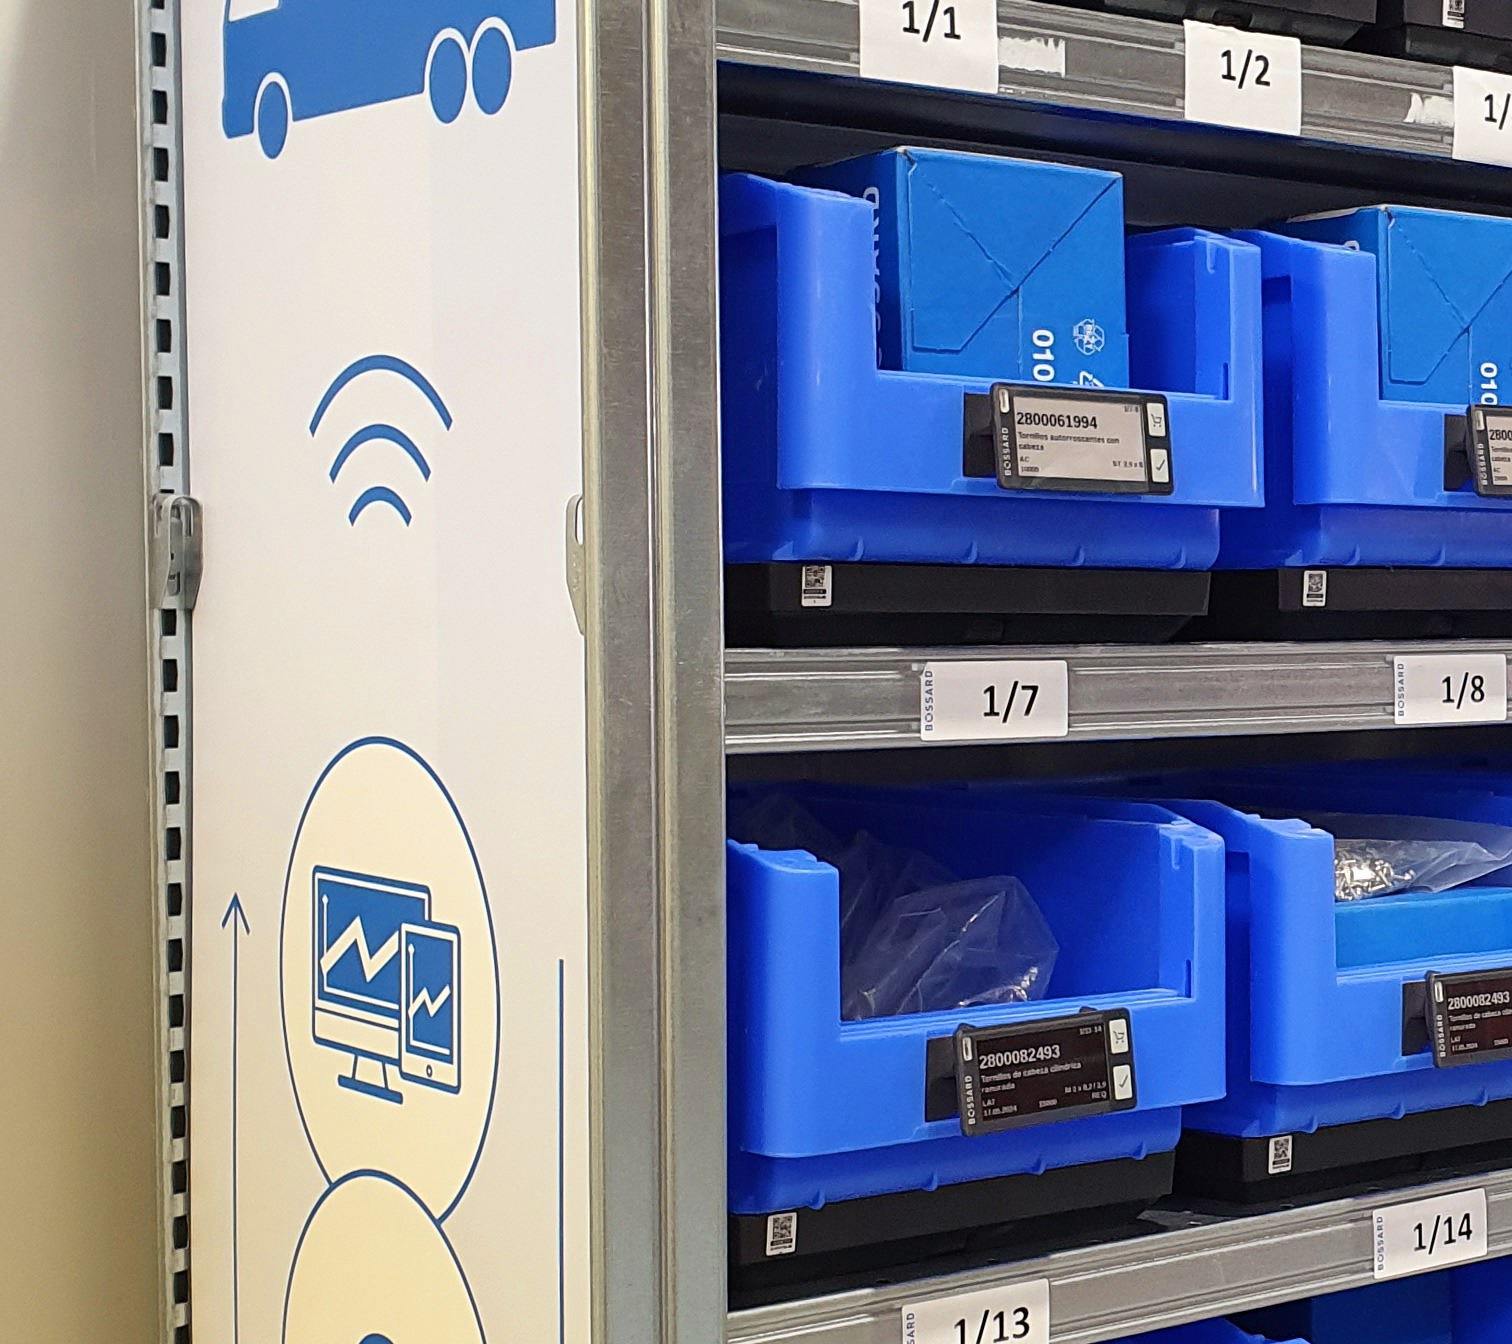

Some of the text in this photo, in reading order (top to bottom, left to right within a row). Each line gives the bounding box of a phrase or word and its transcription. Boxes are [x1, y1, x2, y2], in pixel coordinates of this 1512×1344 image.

[902, 0, 961, 42] 1/1
[1220, 49, 1270, 89] 1/2
[1032, 329, 1055, 381] 010
[1017, 412, 1098, 429] 2800061994
[1002, 427, 1011, 476] BOSSARD
[923, 669, 1040, 732] BOSSARD 1/7
[1396, 663, 1485, 717] BOSSARD 1/8
[1448, 991, 1510, 1010] 2800082493
[979, 1045, 1060, 1069] 2800082493
[965, 1075, 975, 1124] BOSSARD
[1413, 1213, 1472, 1255] 1/14
